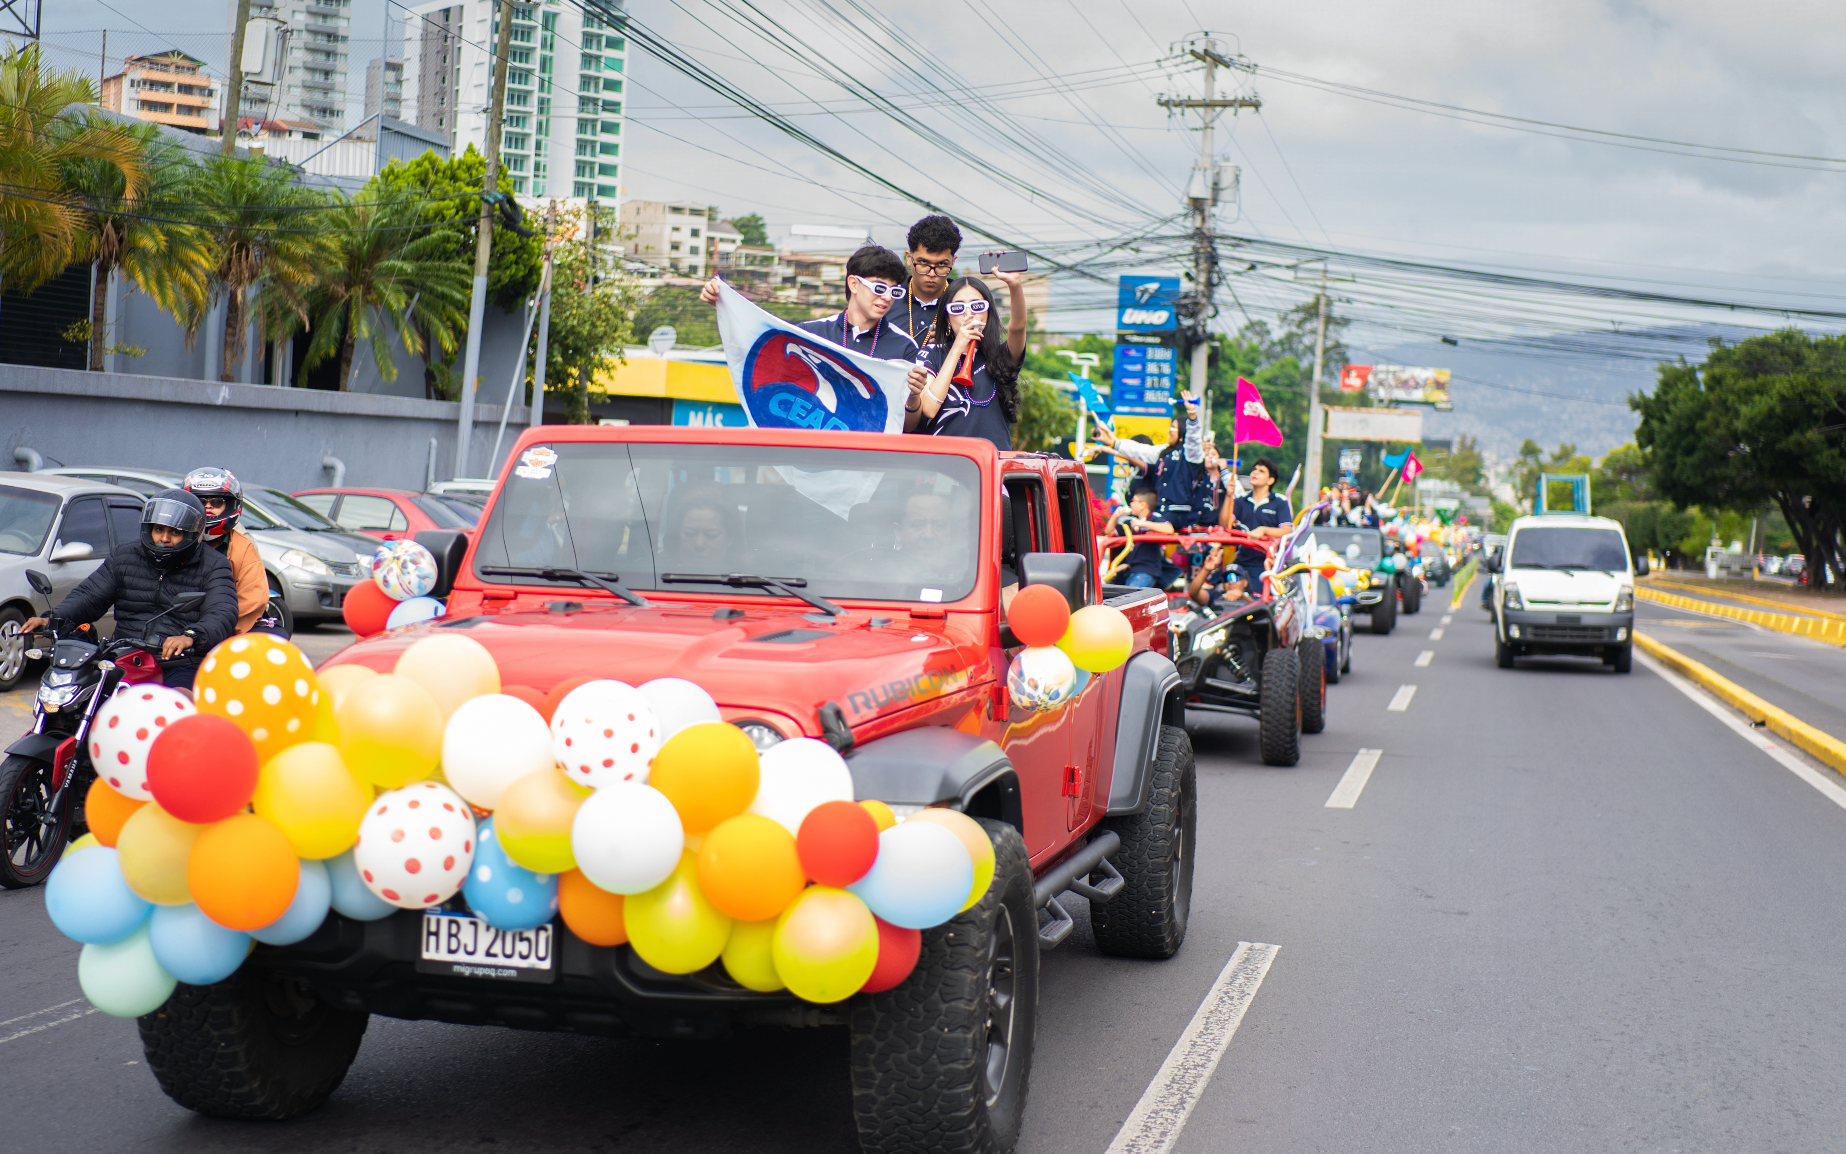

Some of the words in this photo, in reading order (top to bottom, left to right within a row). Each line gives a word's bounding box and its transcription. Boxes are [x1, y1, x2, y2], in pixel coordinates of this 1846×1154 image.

[1121, 308, 1170, 325] UNO
[688, 406, 724, 427] MÁS
[847, 664, 959, 715] RUBICON
[64, 759, 78, 788] YAMAHA
[426, 916, 478, 956] HBJ
[452, 964, 518, 978] migrupoq.com
